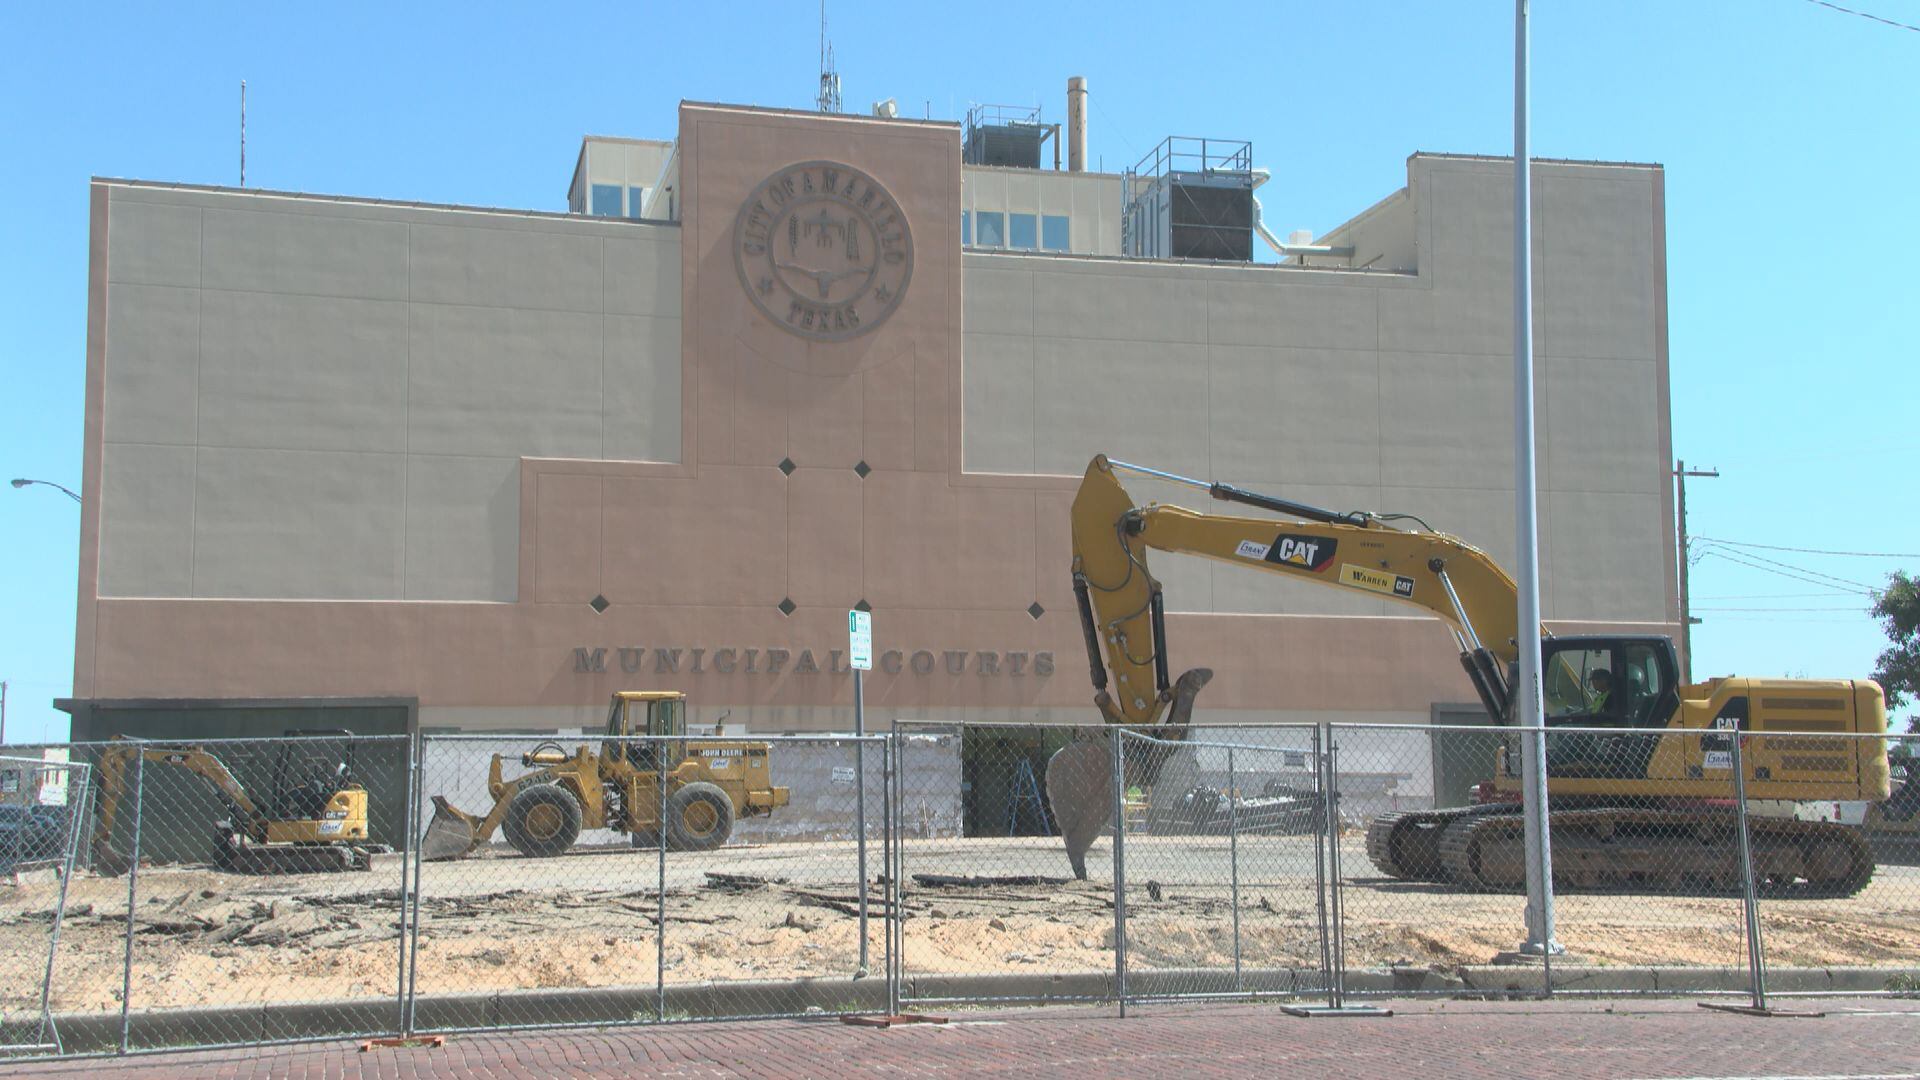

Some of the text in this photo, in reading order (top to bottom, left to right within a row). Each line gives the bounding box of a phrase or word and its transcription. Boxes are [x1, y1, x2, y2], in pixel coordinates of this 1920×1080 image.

[744, 200, 774, 256] CITY
[769, 175, 795, 206] OF
[787, 300, 860, 331] TEXAS
[1279, 537, 1319, 567] CAT
[1352, 570, 1412, 594] WARREN CAT
[574, 647, 1056, 677] MUNICIPAL COURTS
[1716, 718, 1740, 730] CAT
[700, 749, 744, 757] JOHN DEERE
